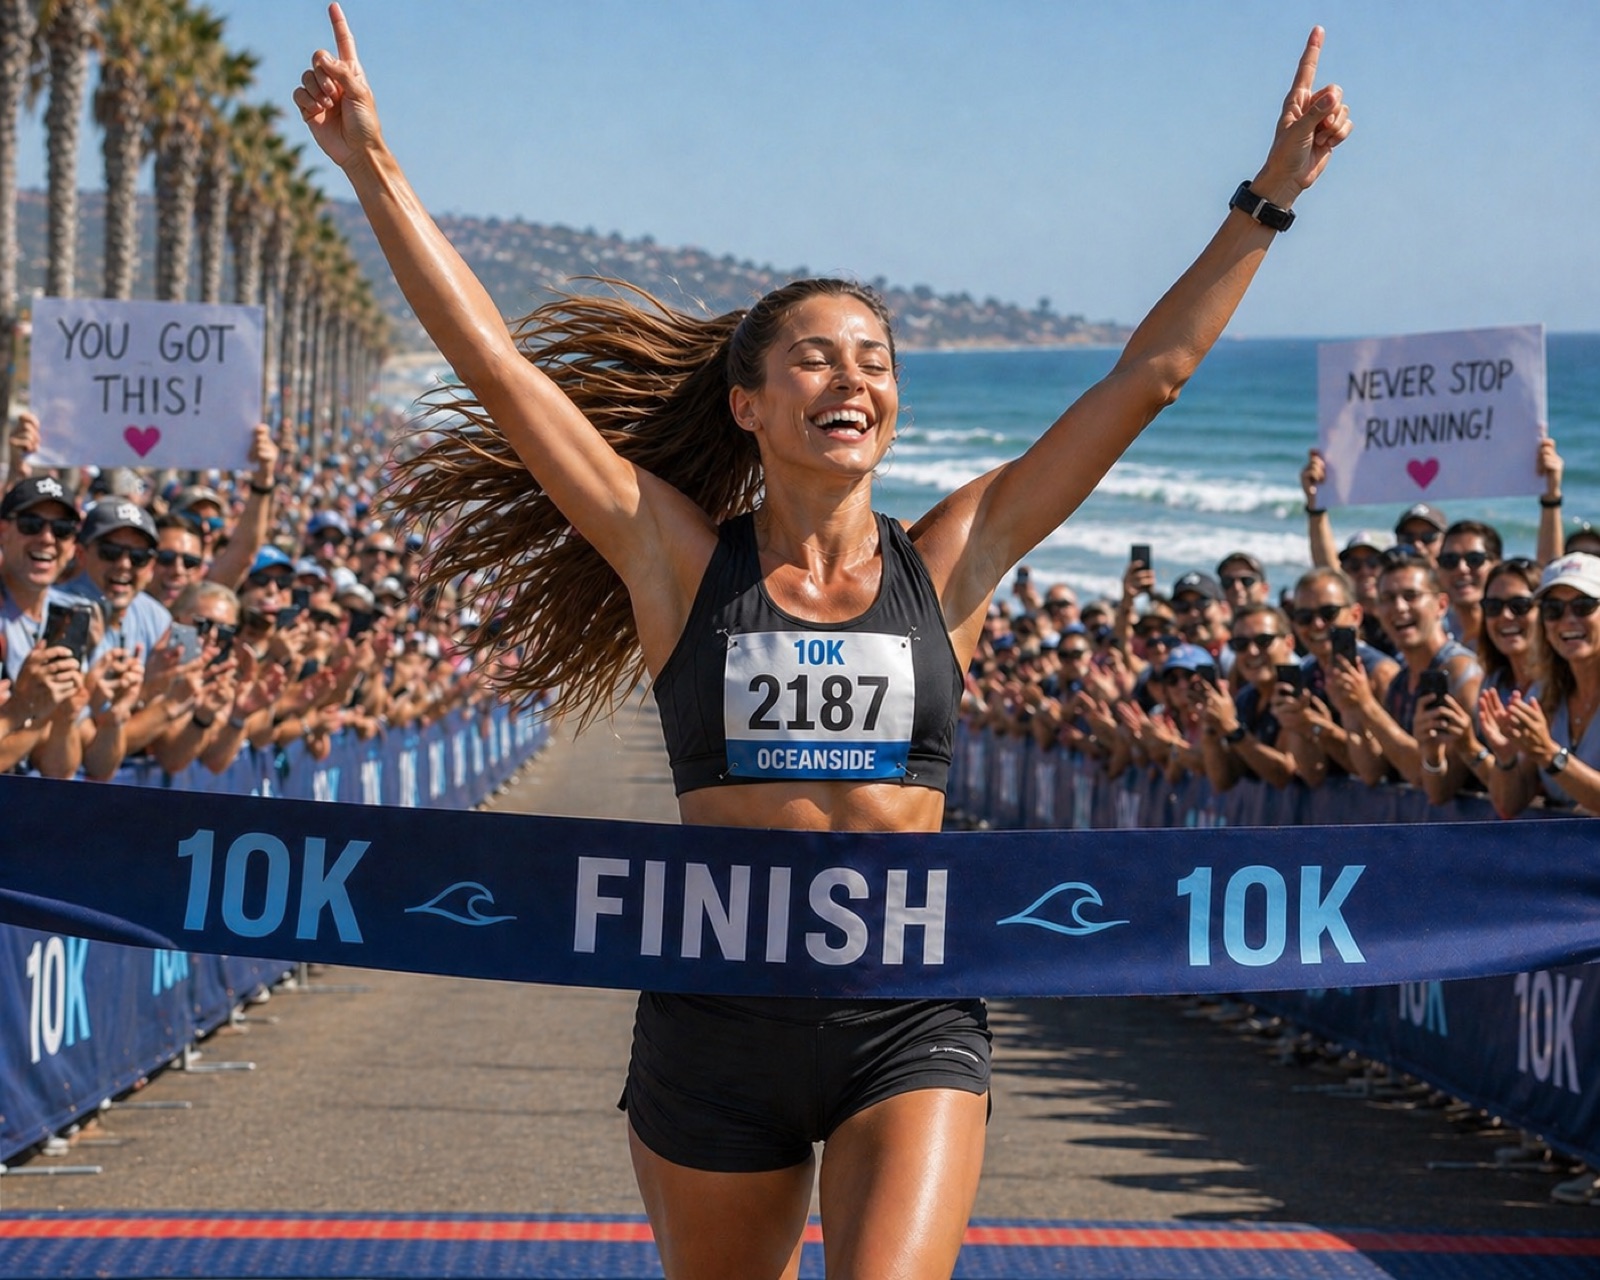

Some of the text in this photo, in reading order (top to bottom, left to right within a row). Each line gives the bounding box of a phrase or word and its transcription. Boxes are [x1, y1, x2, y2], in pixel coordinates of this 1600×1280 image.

[58, 318, 235, 363] YOU GOT
[93, 374, 202, 415] THIS!
[1347, 359, 1513, 402] NEVER STOP
[1365, 406, 1493, 450] RUNNING!
[794, 639, 845, 665] 10K
[748, 673, 889, 731] 2187
[757, 748, 876, 770] OCEANSIDE
[178, 829, 1366, 966] 10K FINISH 10K
[26, 936, 91, 1064] 10K
[1514, 970, 1582, 1094] 10K
